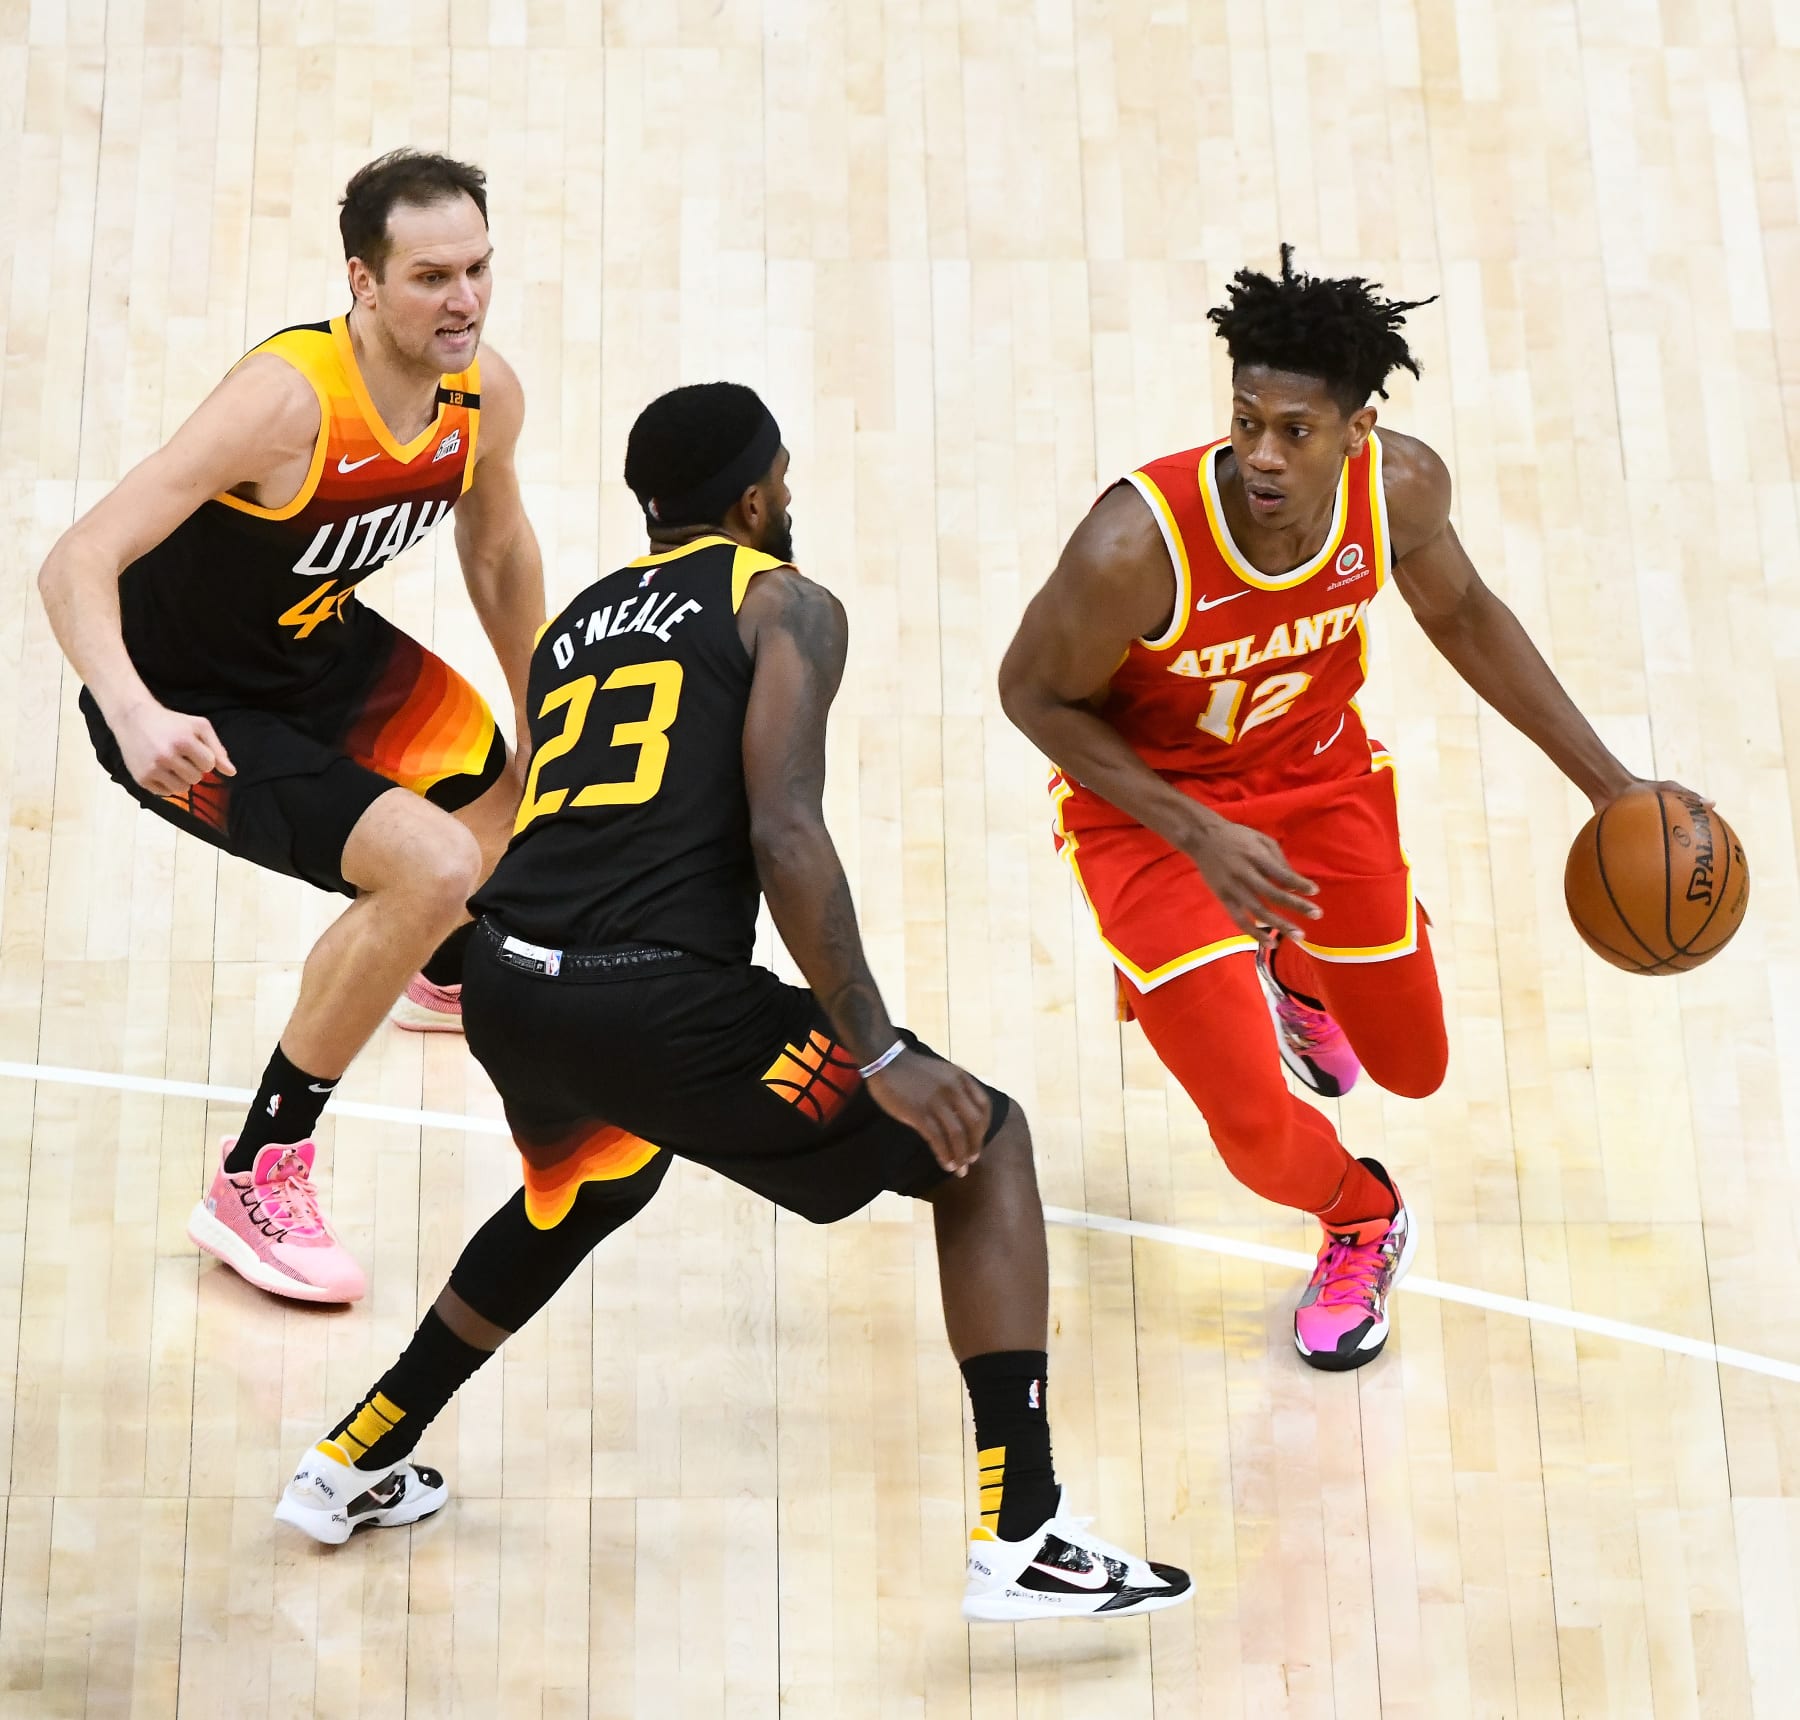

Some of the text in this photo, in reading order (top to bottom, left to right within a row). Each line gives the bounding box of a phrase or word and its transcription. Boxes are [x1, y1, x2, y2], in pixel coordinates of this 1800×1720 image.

[292, 500, 449, 576] UTAH
[1327, 569, 1370, 592] sharecare
[552, 592, 703, 670] O'NEALE
[1195, 671, 1313, 745] 12
[512, 659, 684, 836] 23
[1686, 799, 1714, 906] SPALDIN
